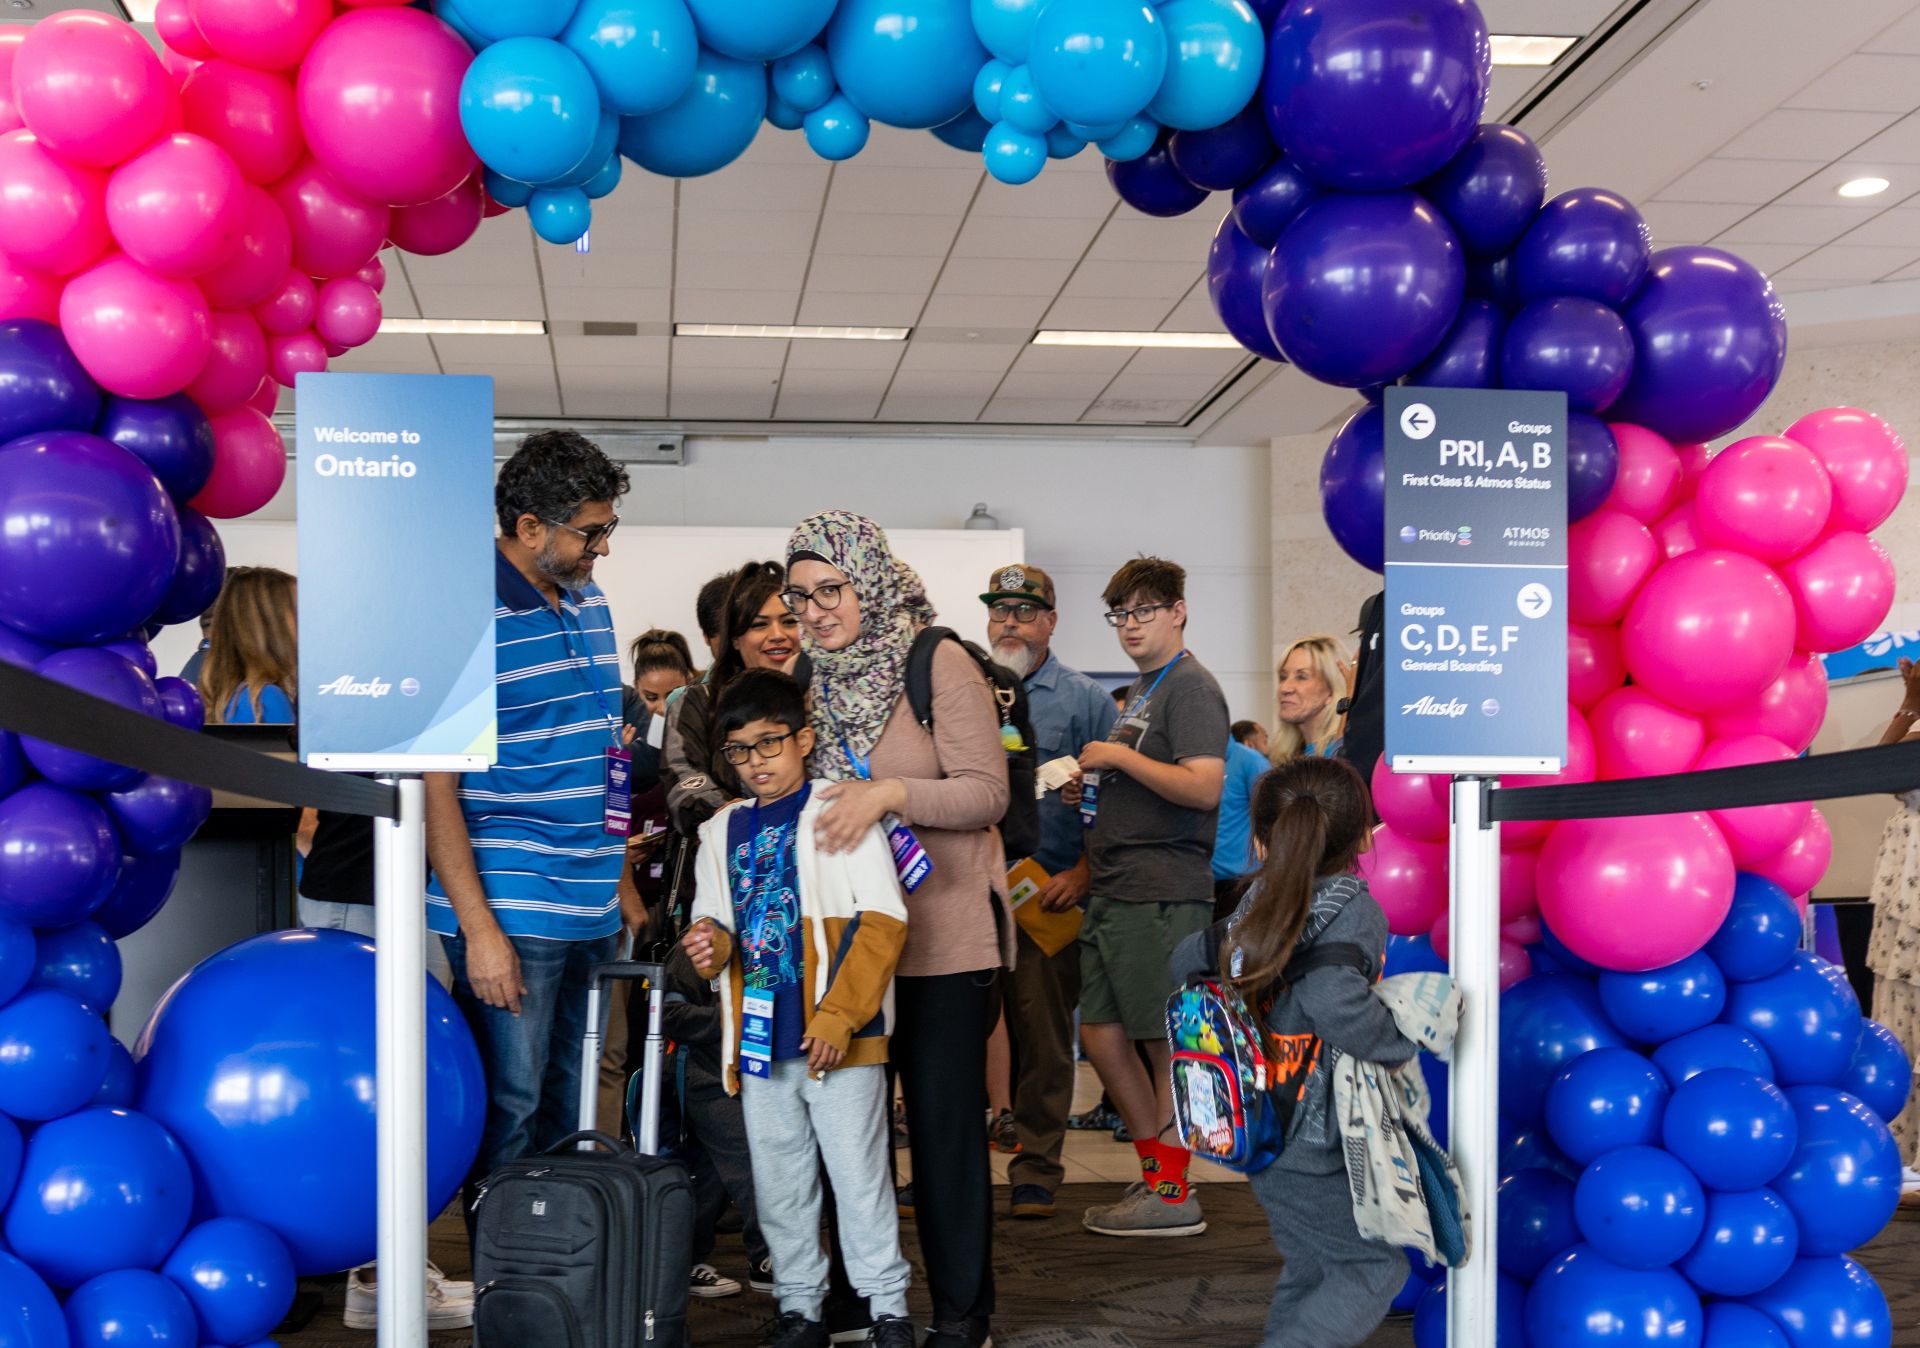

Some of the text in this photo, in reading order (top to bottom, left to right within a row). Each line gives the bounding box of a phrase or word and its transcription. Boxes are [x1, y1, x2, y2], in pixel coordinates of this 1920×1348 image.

[314, 427, 421, 445] Welcome to
[1508, 421, 1552, 436] Groups
[1533, 442, 1552, 468] B
[315, 454, 416, 478] Ontario
[1403, 474, 1552, 490] First Class & Atmos Status
[1419, 528, 1457, 543] Priority
[1503, 527, 1550, 539] ATMOS
[1401, 603, 1446, 617] Groups
[1502, 626, 1519, 652] F
[1401, 659, 1503, 675] General Boarding
[318, 675, 392, 698] Alaska
[1401, 696, 1468, 718] Alaska
